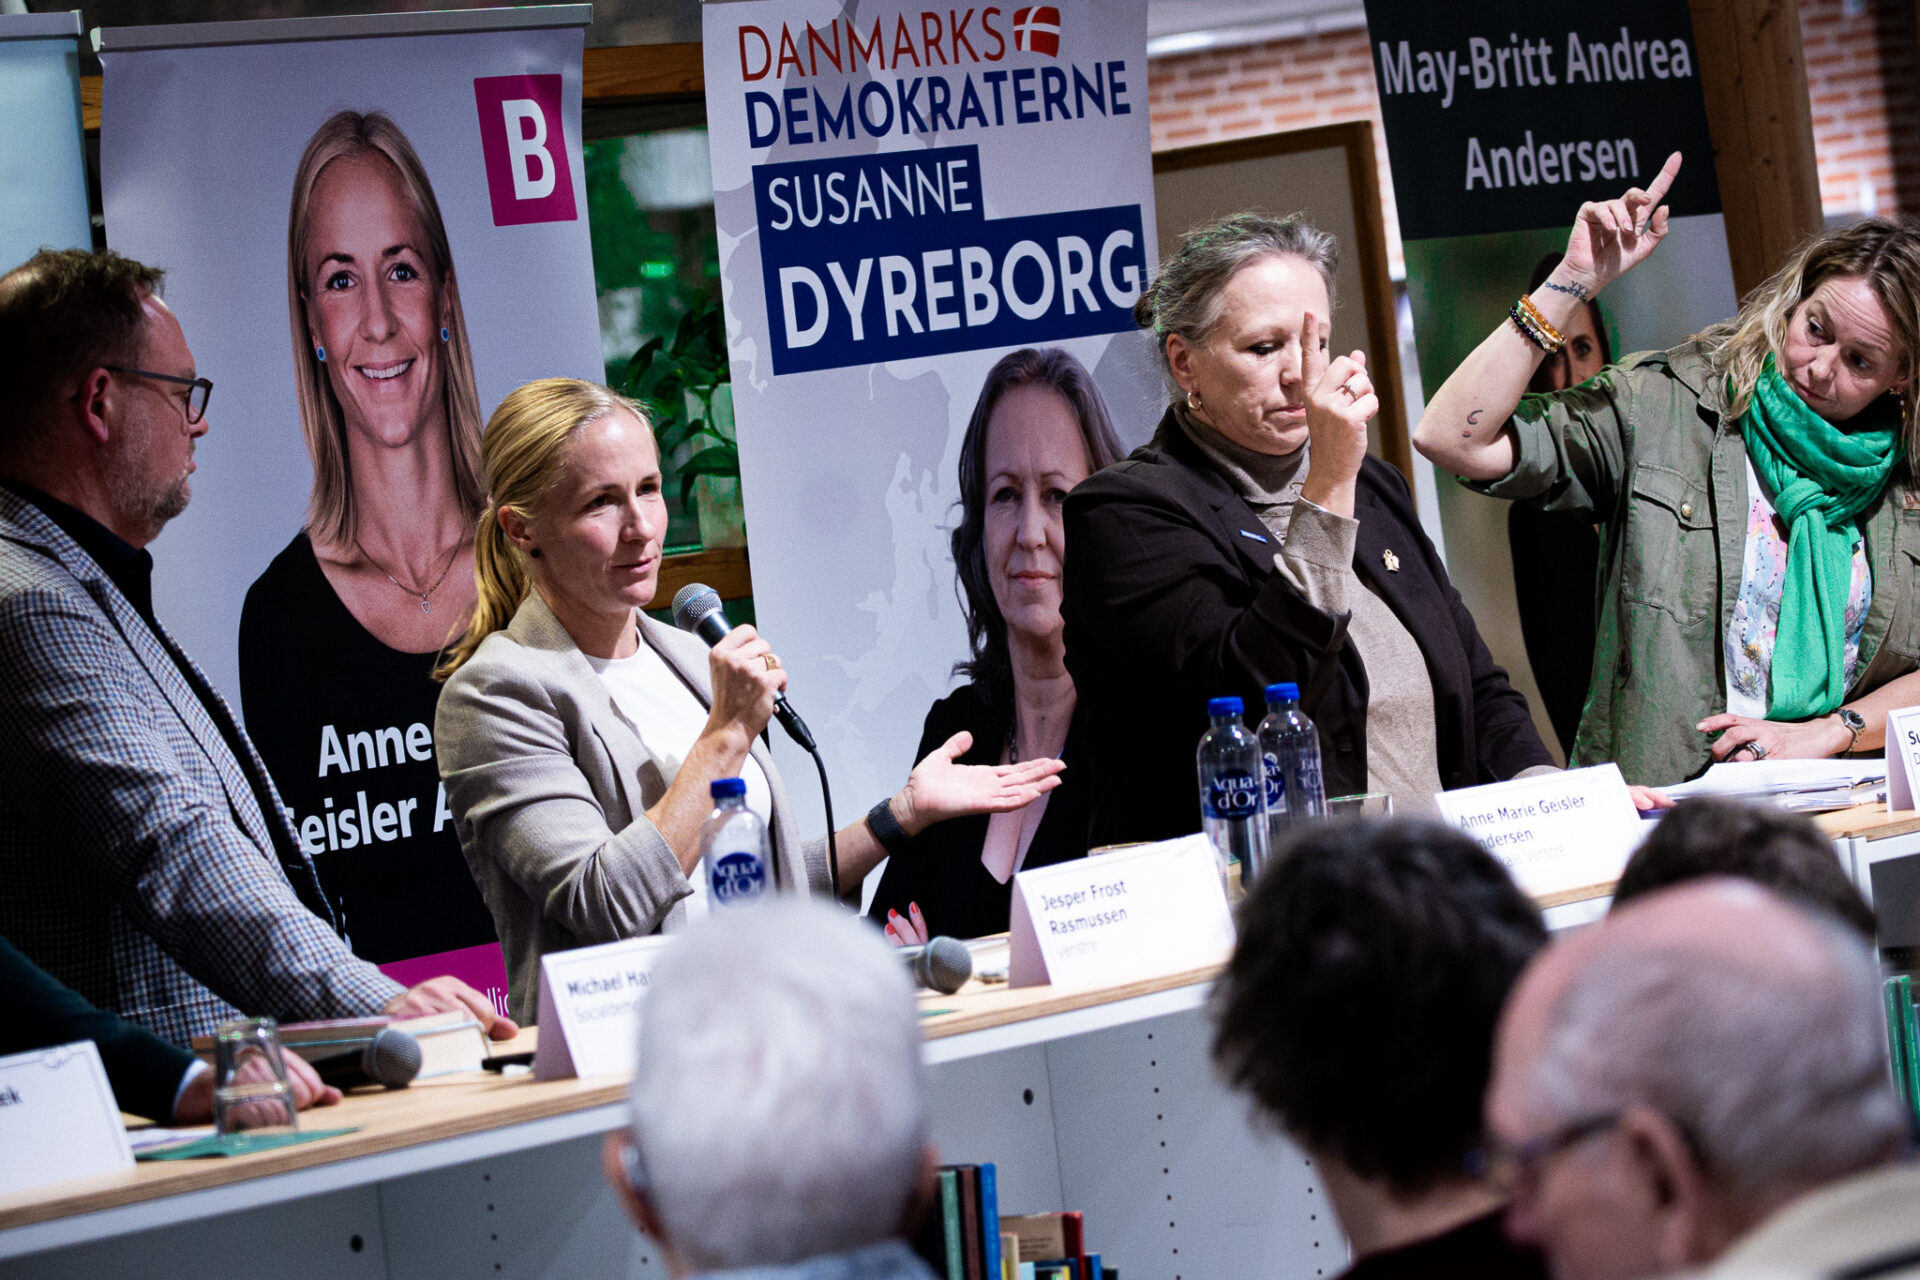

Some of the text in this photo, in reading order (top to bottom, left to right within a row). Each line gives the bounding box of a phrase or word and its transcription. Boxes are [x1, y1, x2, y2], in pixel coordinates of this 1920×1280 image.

[738, 6, 1006, 82] DANMARKS
[1379, 26, 1693, 109] May-Britt Andrea
[744, 60, 1132, 149] DEMOKRATERNE
[502, 98, 556, 200] B
[1465, 130, 1640, 191] Andersen
[768, 159, 973, 232] SUSANNE
[779, 229, 1143, 349] DYREBORG
[318, 722, 433, 778] Anne
[286, 790, 418, 855] eisler
[1460, 795, 1585, 829] Anne Marie Geisler
[1479, 829, 1534, 850] ndersen
[1041, 879, 1127, 911] Jesper Frost
[1049, 907, 1128, 935] Rasmussen
